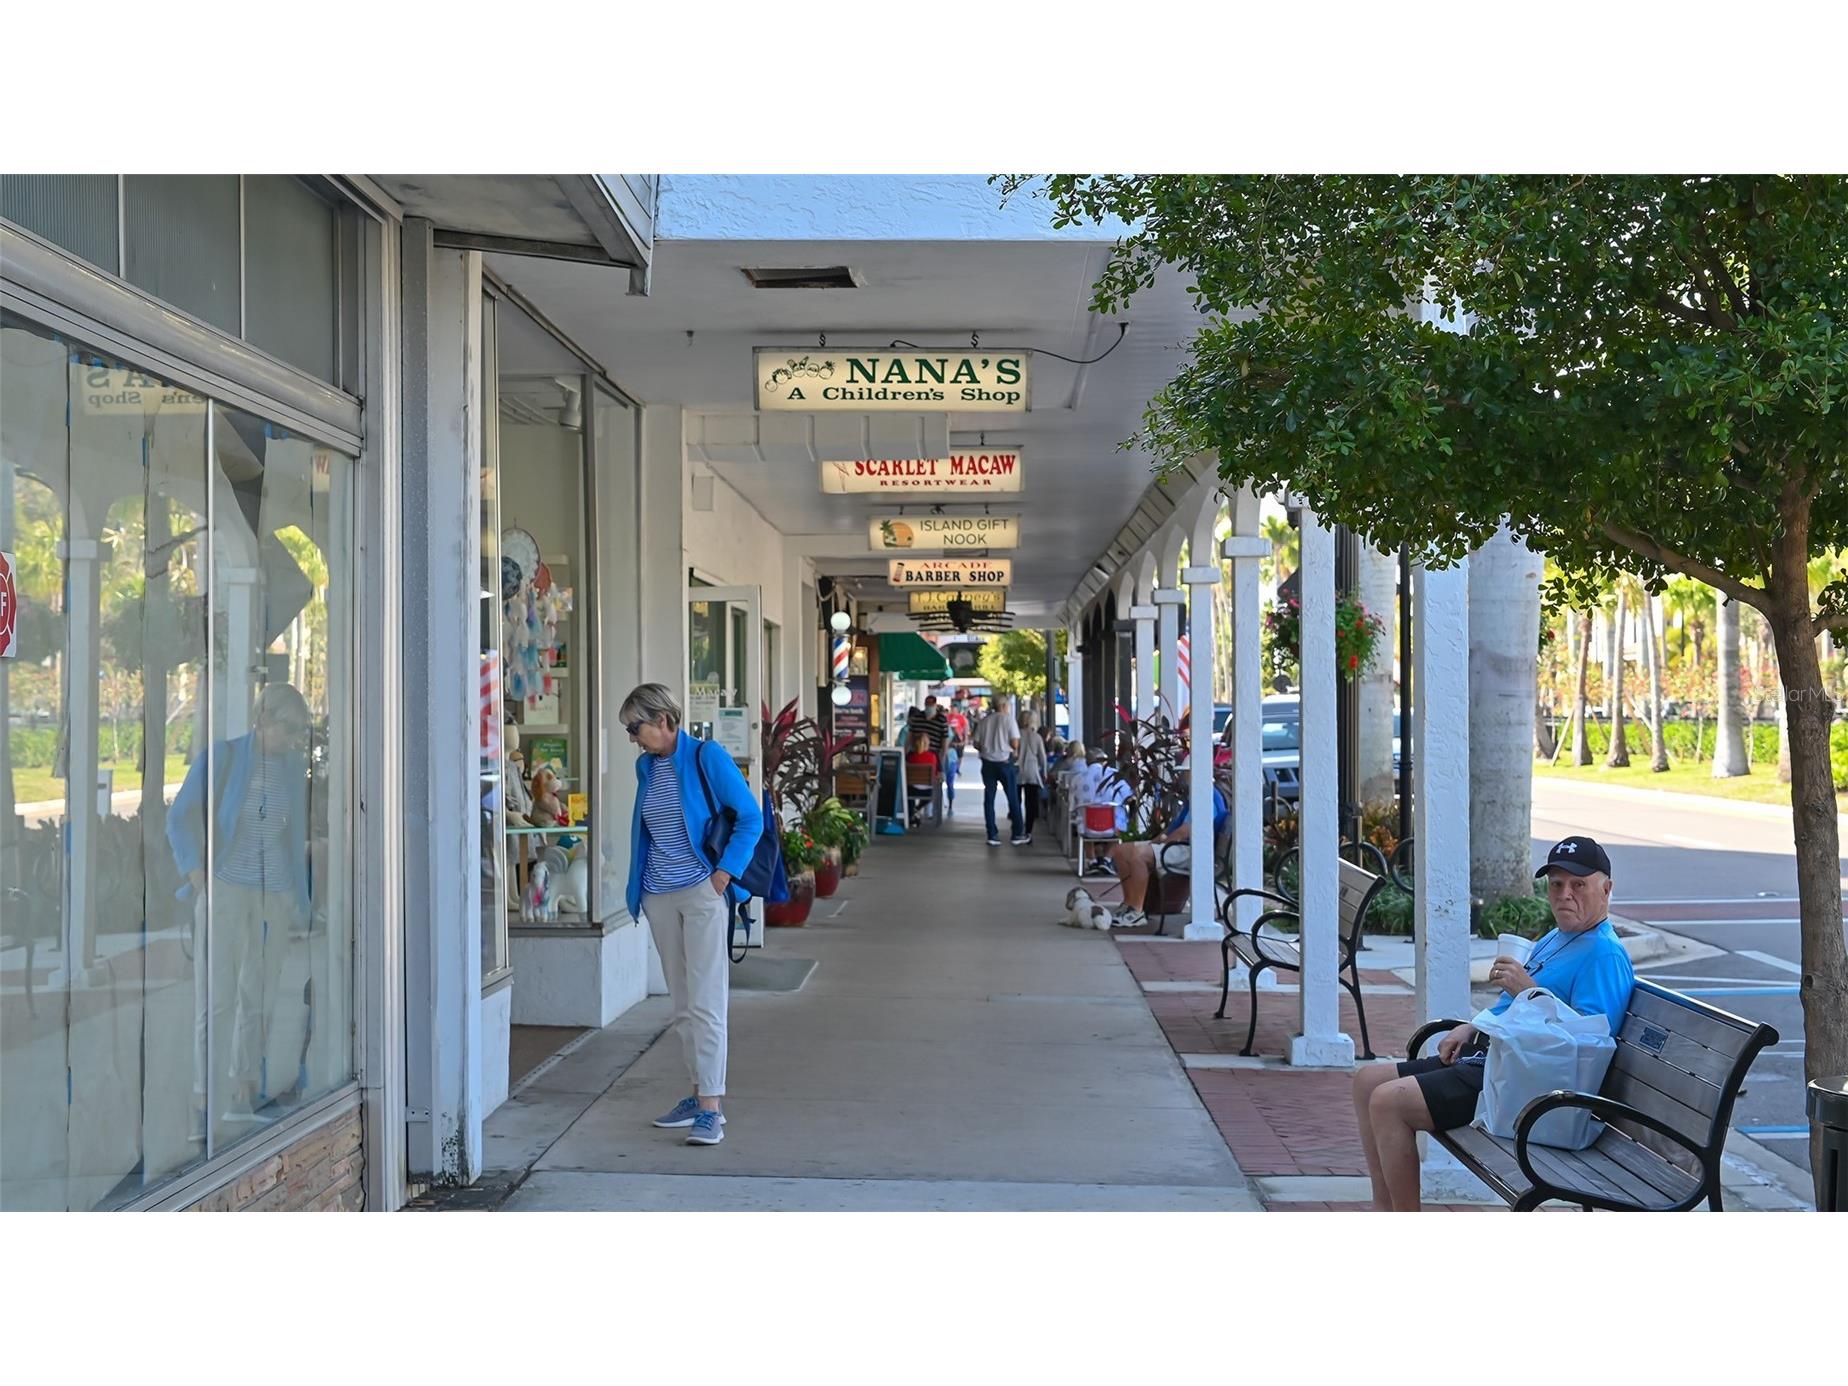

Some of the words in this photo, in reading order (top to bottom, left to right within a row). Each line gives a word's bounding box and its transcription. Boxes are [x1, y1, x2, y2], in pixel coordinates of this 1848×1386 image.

[846, 358, 1021, 384] NANA'S
[787, 387, 806, 400] A
[822, 387, 944, 400] Children's
[960, 387, 1020, 404] Shop
[854, 459, 939, 476] SCARLET
[950, 455, 1016, 475] MACAW
[920, 520, 972, 531] ISLAND
[977, 519, 1008, 530] GIFT
[943, 534, 986, 544] NOOK
[905, 571, 960, 581] BARBER
[969, 571, 1004, 581] SHOP
